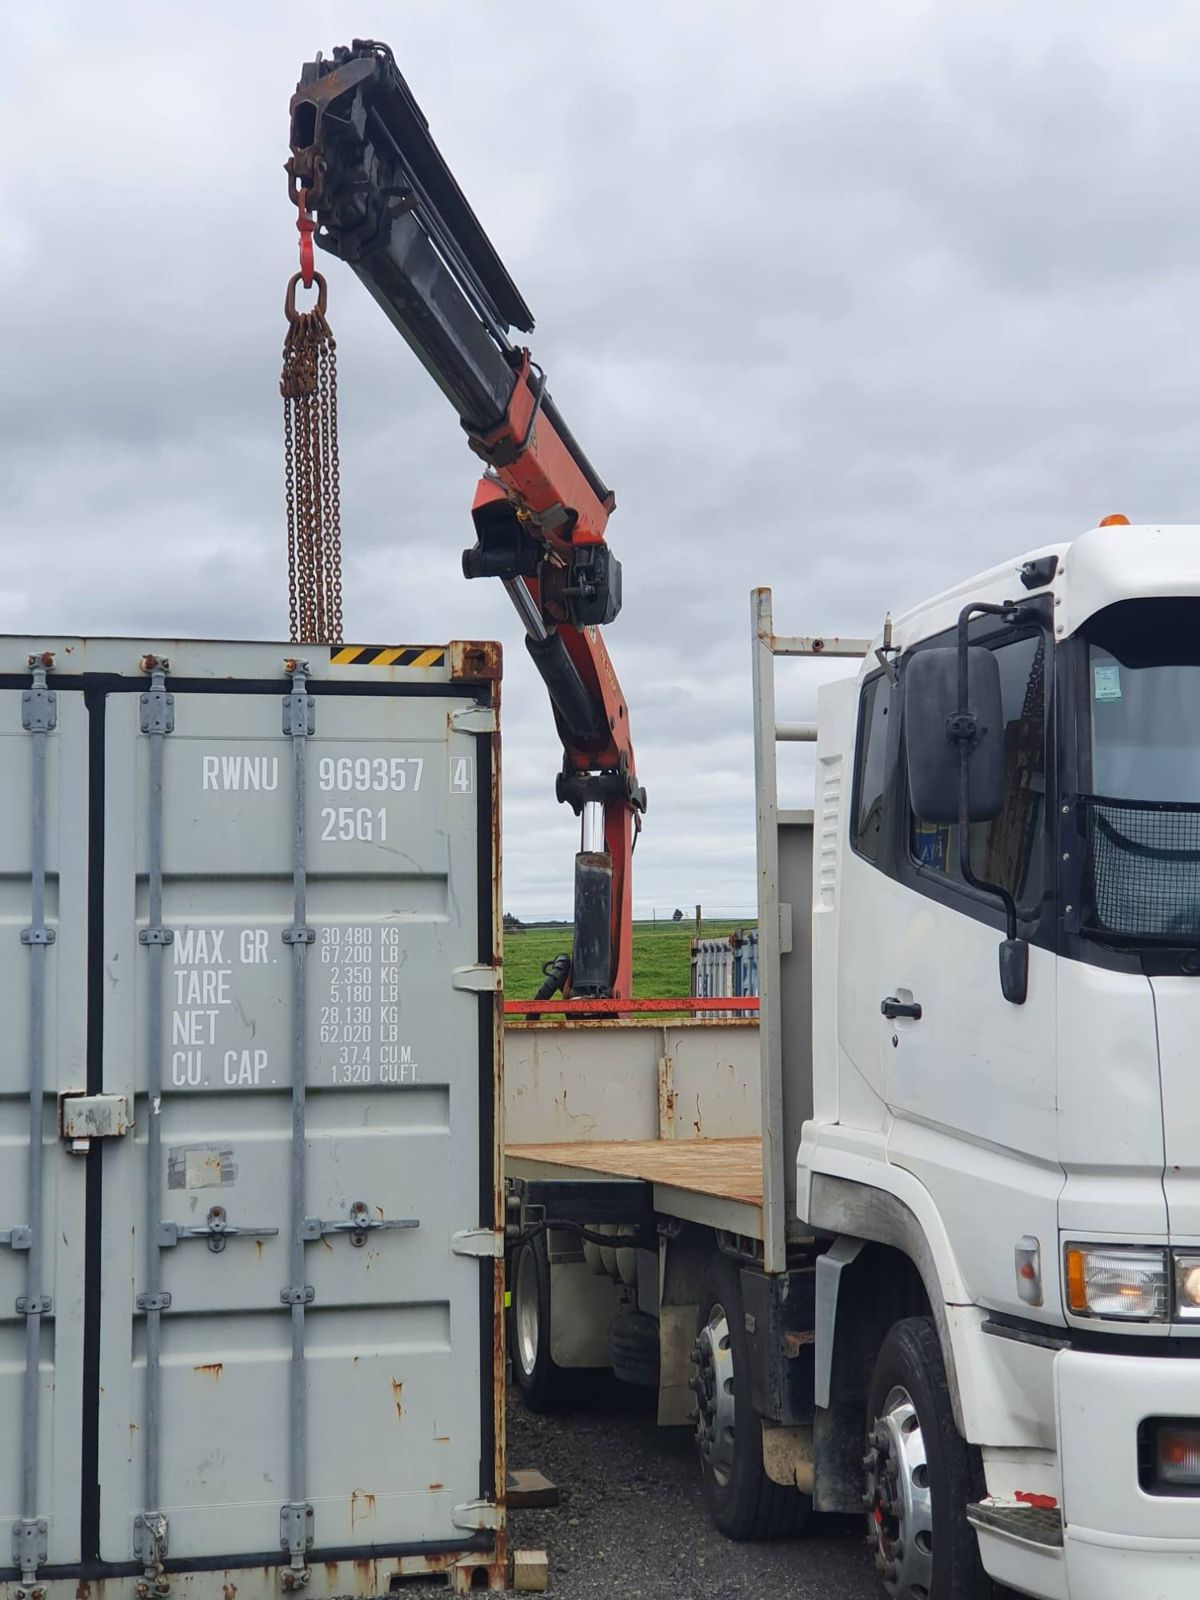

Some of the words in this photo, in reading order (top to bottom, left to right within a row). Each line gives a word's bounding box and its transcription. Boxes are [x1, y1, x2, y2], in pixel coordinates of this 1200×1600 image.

[202, 756, 278, 790] RWNU
[319, 758, 424, 791] 969357
[453, 758, 469, 791] 4
[321, 807, 387, 841] 25G1
[380, 927, 399, 944] KG
[173, 930, 232, 964] MAX.
[240, 929, 277, 963] GR.
[380, 945, 399, 963] LB
[380, 966, 398, 984] KG
[173, 969, 232, 1004] TARE
[380, 985, 398, 1002] LB
[380, 1006, 398, 1023] KG
[172, 1010, 219, 1045] NET
[380, 1024, 398, 1042] LB
[339, 1045, 370, 1064] 37.4
[380, 1045, 414, 1063] CU.M.
[172, 1050, 209, 1086] CU.
[224, 1049, 276, 1085] CAP.
